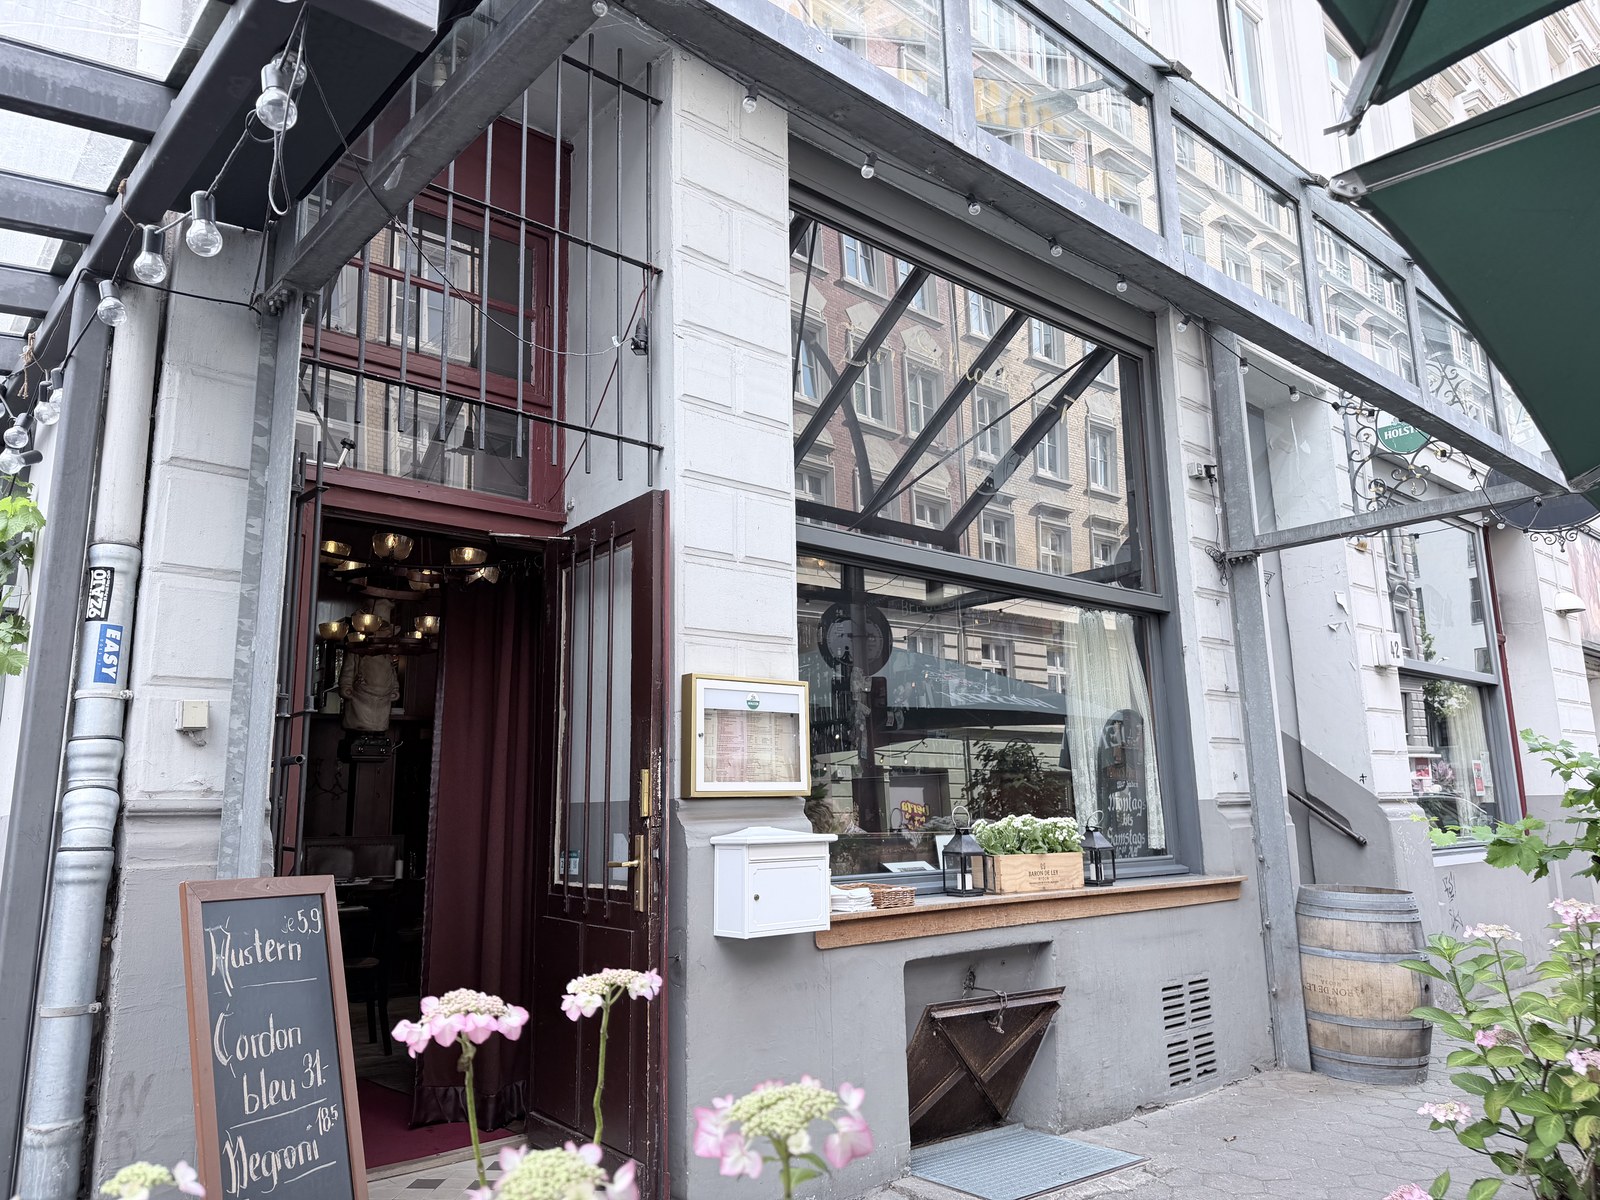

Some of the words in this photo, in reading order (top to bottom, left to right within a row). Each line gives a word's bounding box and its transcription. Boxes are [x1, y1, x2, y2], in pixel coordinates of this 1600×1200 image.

[1384, 425, 1416, 440] HOLST
[101, 628, 121, 680] EASY
[1391, 641, 1400, 658] 42
[281, 915, 295, 934] je
[297, 907, 322, 936] 5,9
[204, 916, 302, 997] Austern
[213, 1004, 302, 1078] Cordon
[242, 1067, 296, 1115] bleu
[222, 1130, 320, 1197] Negroni
